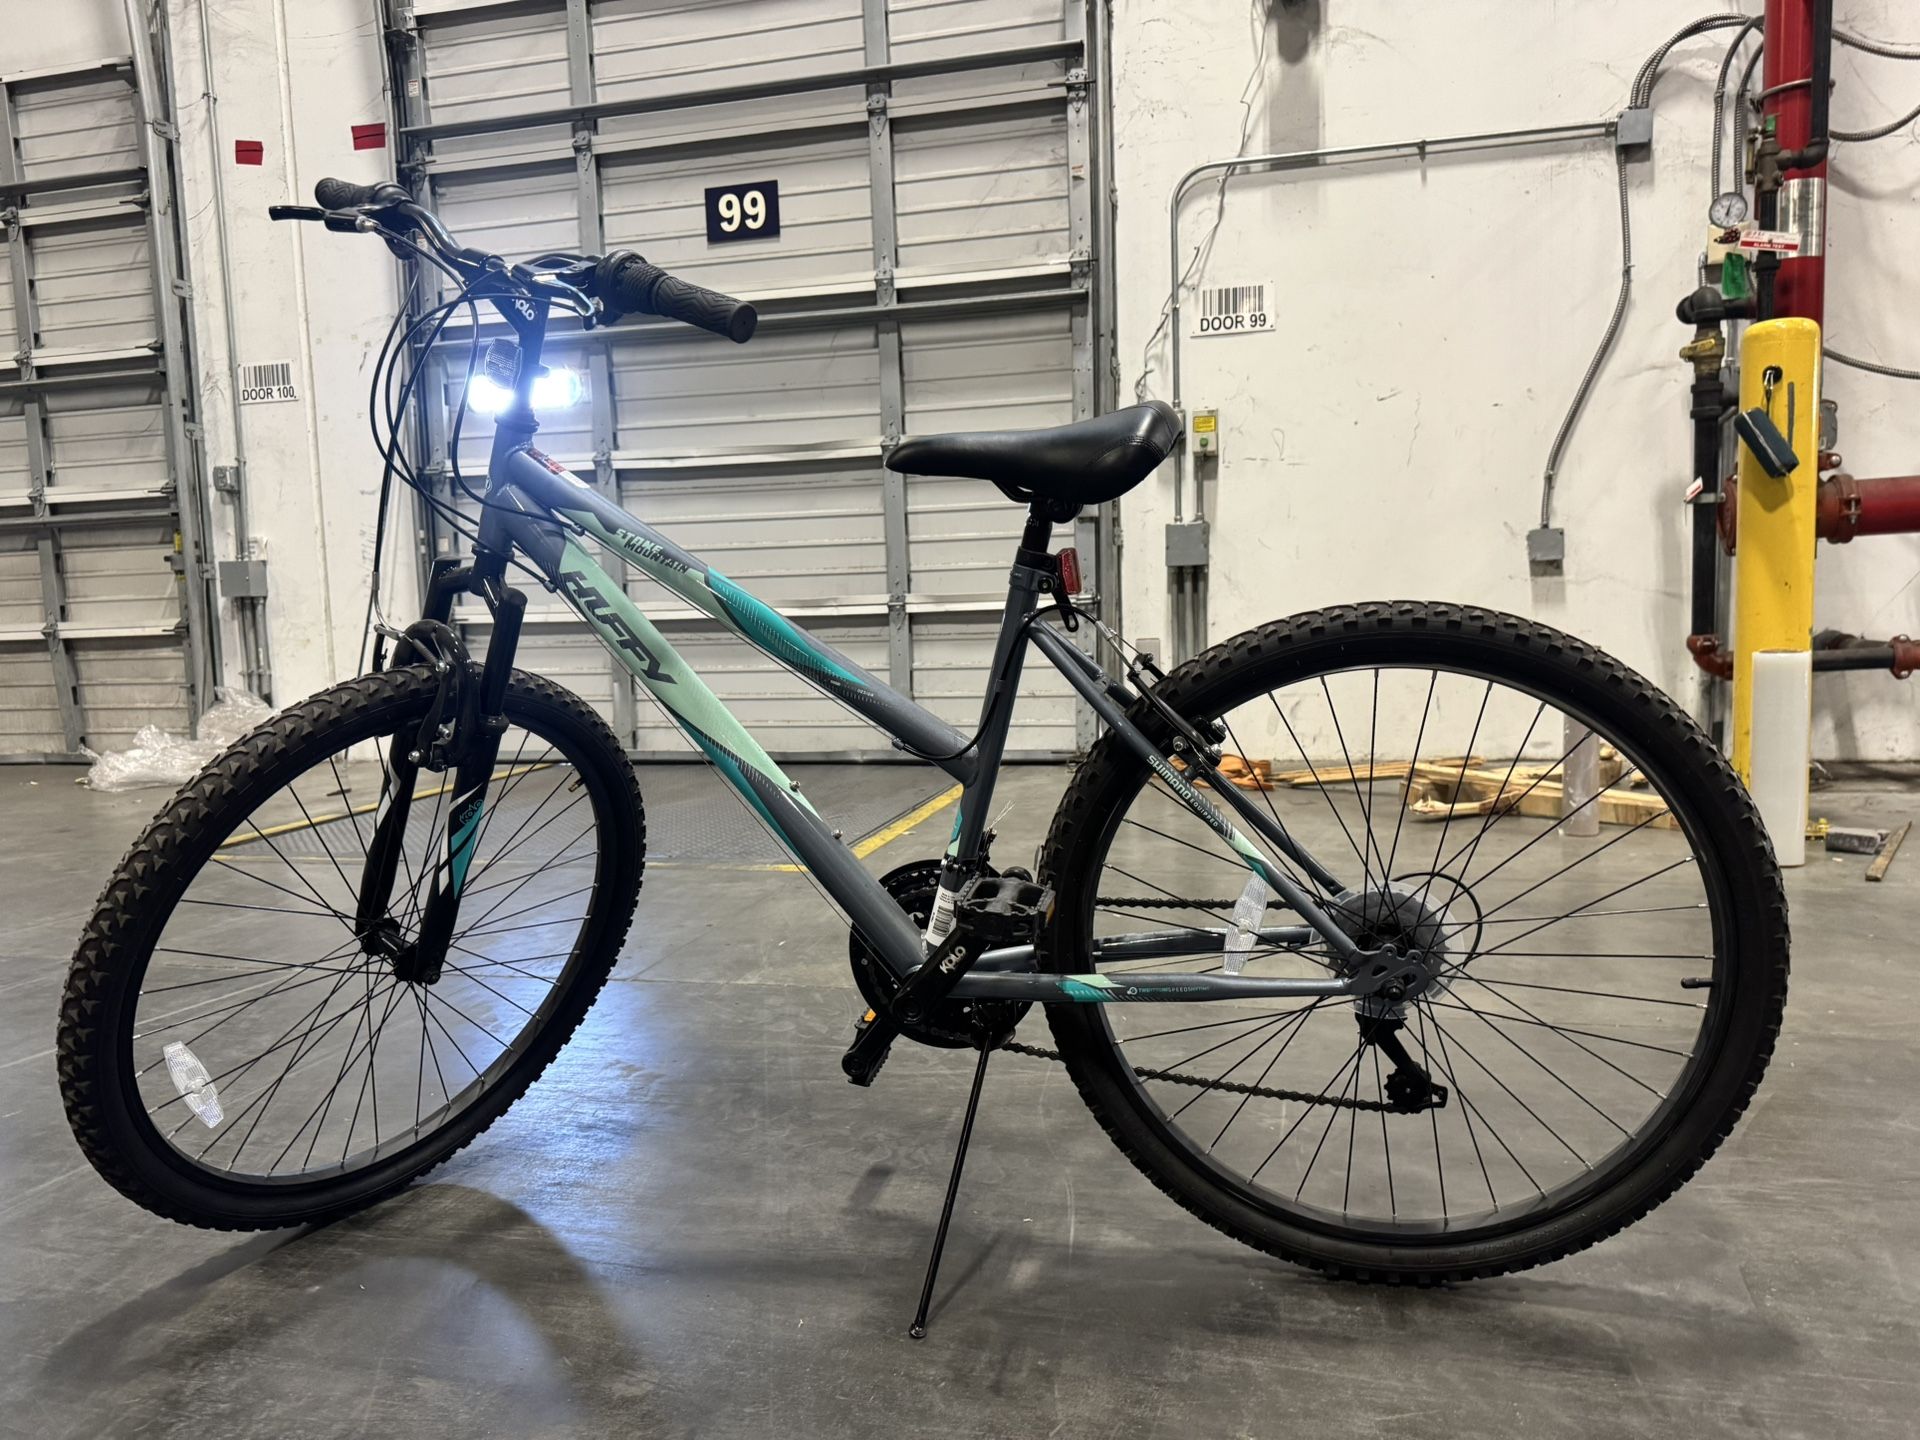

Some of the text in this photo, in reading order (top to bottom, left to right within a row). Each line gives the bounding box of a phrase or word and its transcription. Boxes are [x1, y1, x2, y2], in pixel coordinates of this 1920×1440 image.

[718, 190, 767, 233] 99
[1200, 313, 1267, 332] DOOR 99
[242, 385, 295, 401] DOOR 100
[616, 528, 663, 553] STONE
[624, 539, 689, 575] MOUNTAIN
[560, 570, 678, 685] HUFFY
[1147, 755, 1219, 827] SHIMANO EQUIPPED
[940, 946, 966, 973] KOLO
